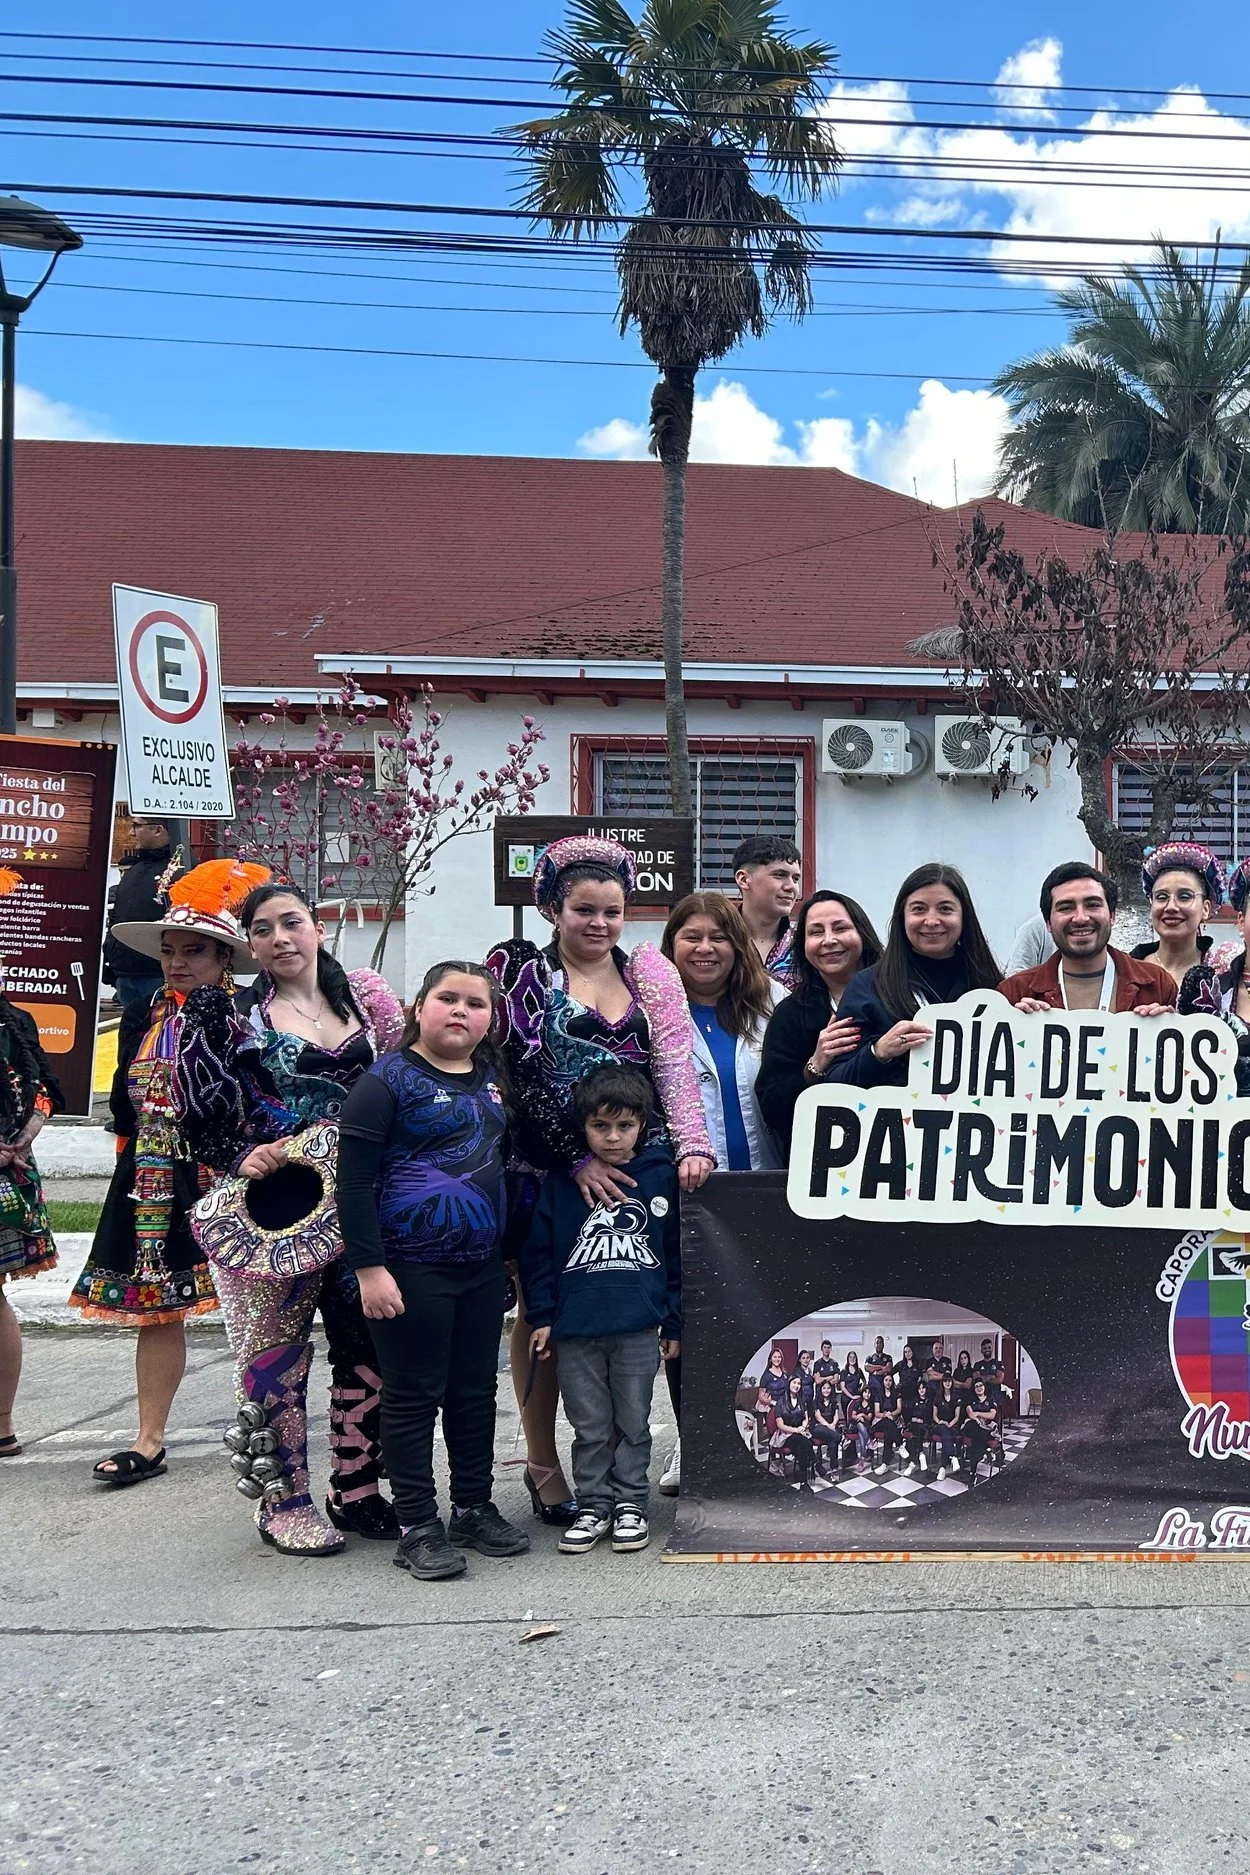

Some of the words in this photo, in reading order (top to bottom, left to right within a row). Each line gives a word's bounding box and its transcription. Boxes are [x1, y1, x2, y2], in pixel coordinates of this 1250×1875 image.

[155, 635, 190, 703] E
[142, 736, 215, 762] EXCLUSIVO
[0, 773, 39, 790] iesta
[42, 777, 66, 792] del
[152, 764, 212, 788] ALCALDE
[201, 801, 224, 811] 2020
[0, 847, 18, 860] 25
[657, 851, 675, 864] DE
[632, 867, 674, 892] ÓN
[931, 1004, 1016, 1099] DÍA
[1040, 1024, 1106, 1101] DE
[1126, 1027, 1220, 1105] LOS
[1146, 1508, 1201, 1549] La
